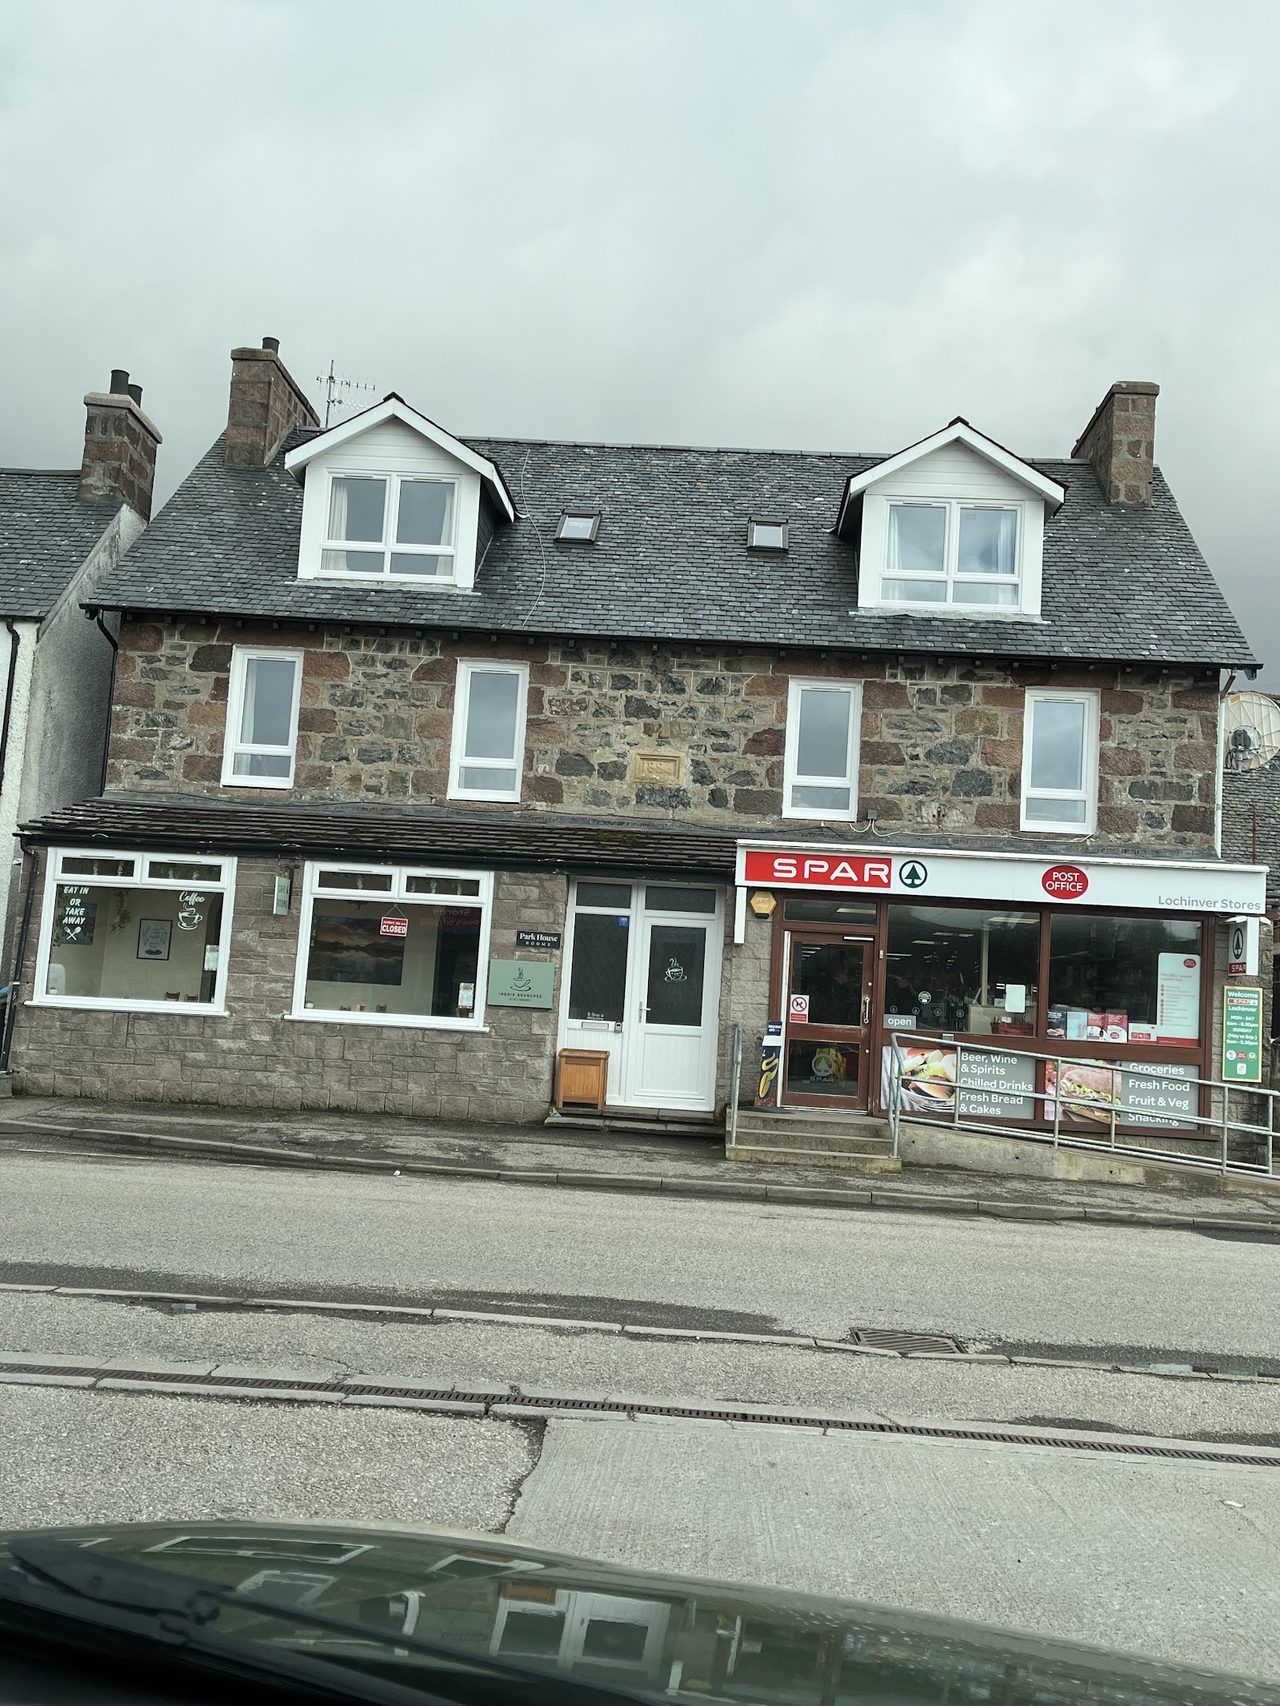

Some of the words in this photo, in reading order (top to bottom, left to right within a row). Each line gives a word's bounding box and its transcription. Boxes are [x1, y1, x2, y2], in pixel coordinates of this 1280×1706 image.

[773, 858, 889, 883] SPAR
[1052, 871, 1080, 881] POST
[64, 886, 79, 894] EAT
[79, 887, 89, 895] IN
[1046, 880, 1083, 892] OFFICE
[69, 898, 81, 907] OR
[179, 891, 205, 906] Coffee
[1158, 895, 1219, 908] Lochinver
[1220, 898, 1261, 911] Stores
[65, 907, 85, 916] TAKE
[62, 916, 86, 925] AWAY
[382, 924, 407, 934] CLOSED
[520, 932, 536, 941] Park
[537, 934, 559, 942] House
[887, 1017, 913, 1028] open
[961, 1052, 988, 1064] Beer,
[990, 1054, 1018, 1065] Wine
[960, 1063, 970, 1073] &
[970, 1064, 1006, 1076] Spirits
[1129, 1062, 1185, 1075] Groceries
[960, 1077, 998, 1089] Chilled
[998, 1079, 1034, 1092] Drinks
[1128, 1079, 1160, 1090] Fresh
[1161, 1081, 1190, 1092] Food
[959, 1091, 990, 1103] Fresh
[991, 1094, 1024, 1105] Bread
[1128, 1095, 1156, 1106] Fruit
[1157, 1096, 1167, 1107] &
[1168, 1097, 1190, 1111] Veg
[959, 1103, 968, 1113] &
[969, 1104, 1001, 1115] Cakes
